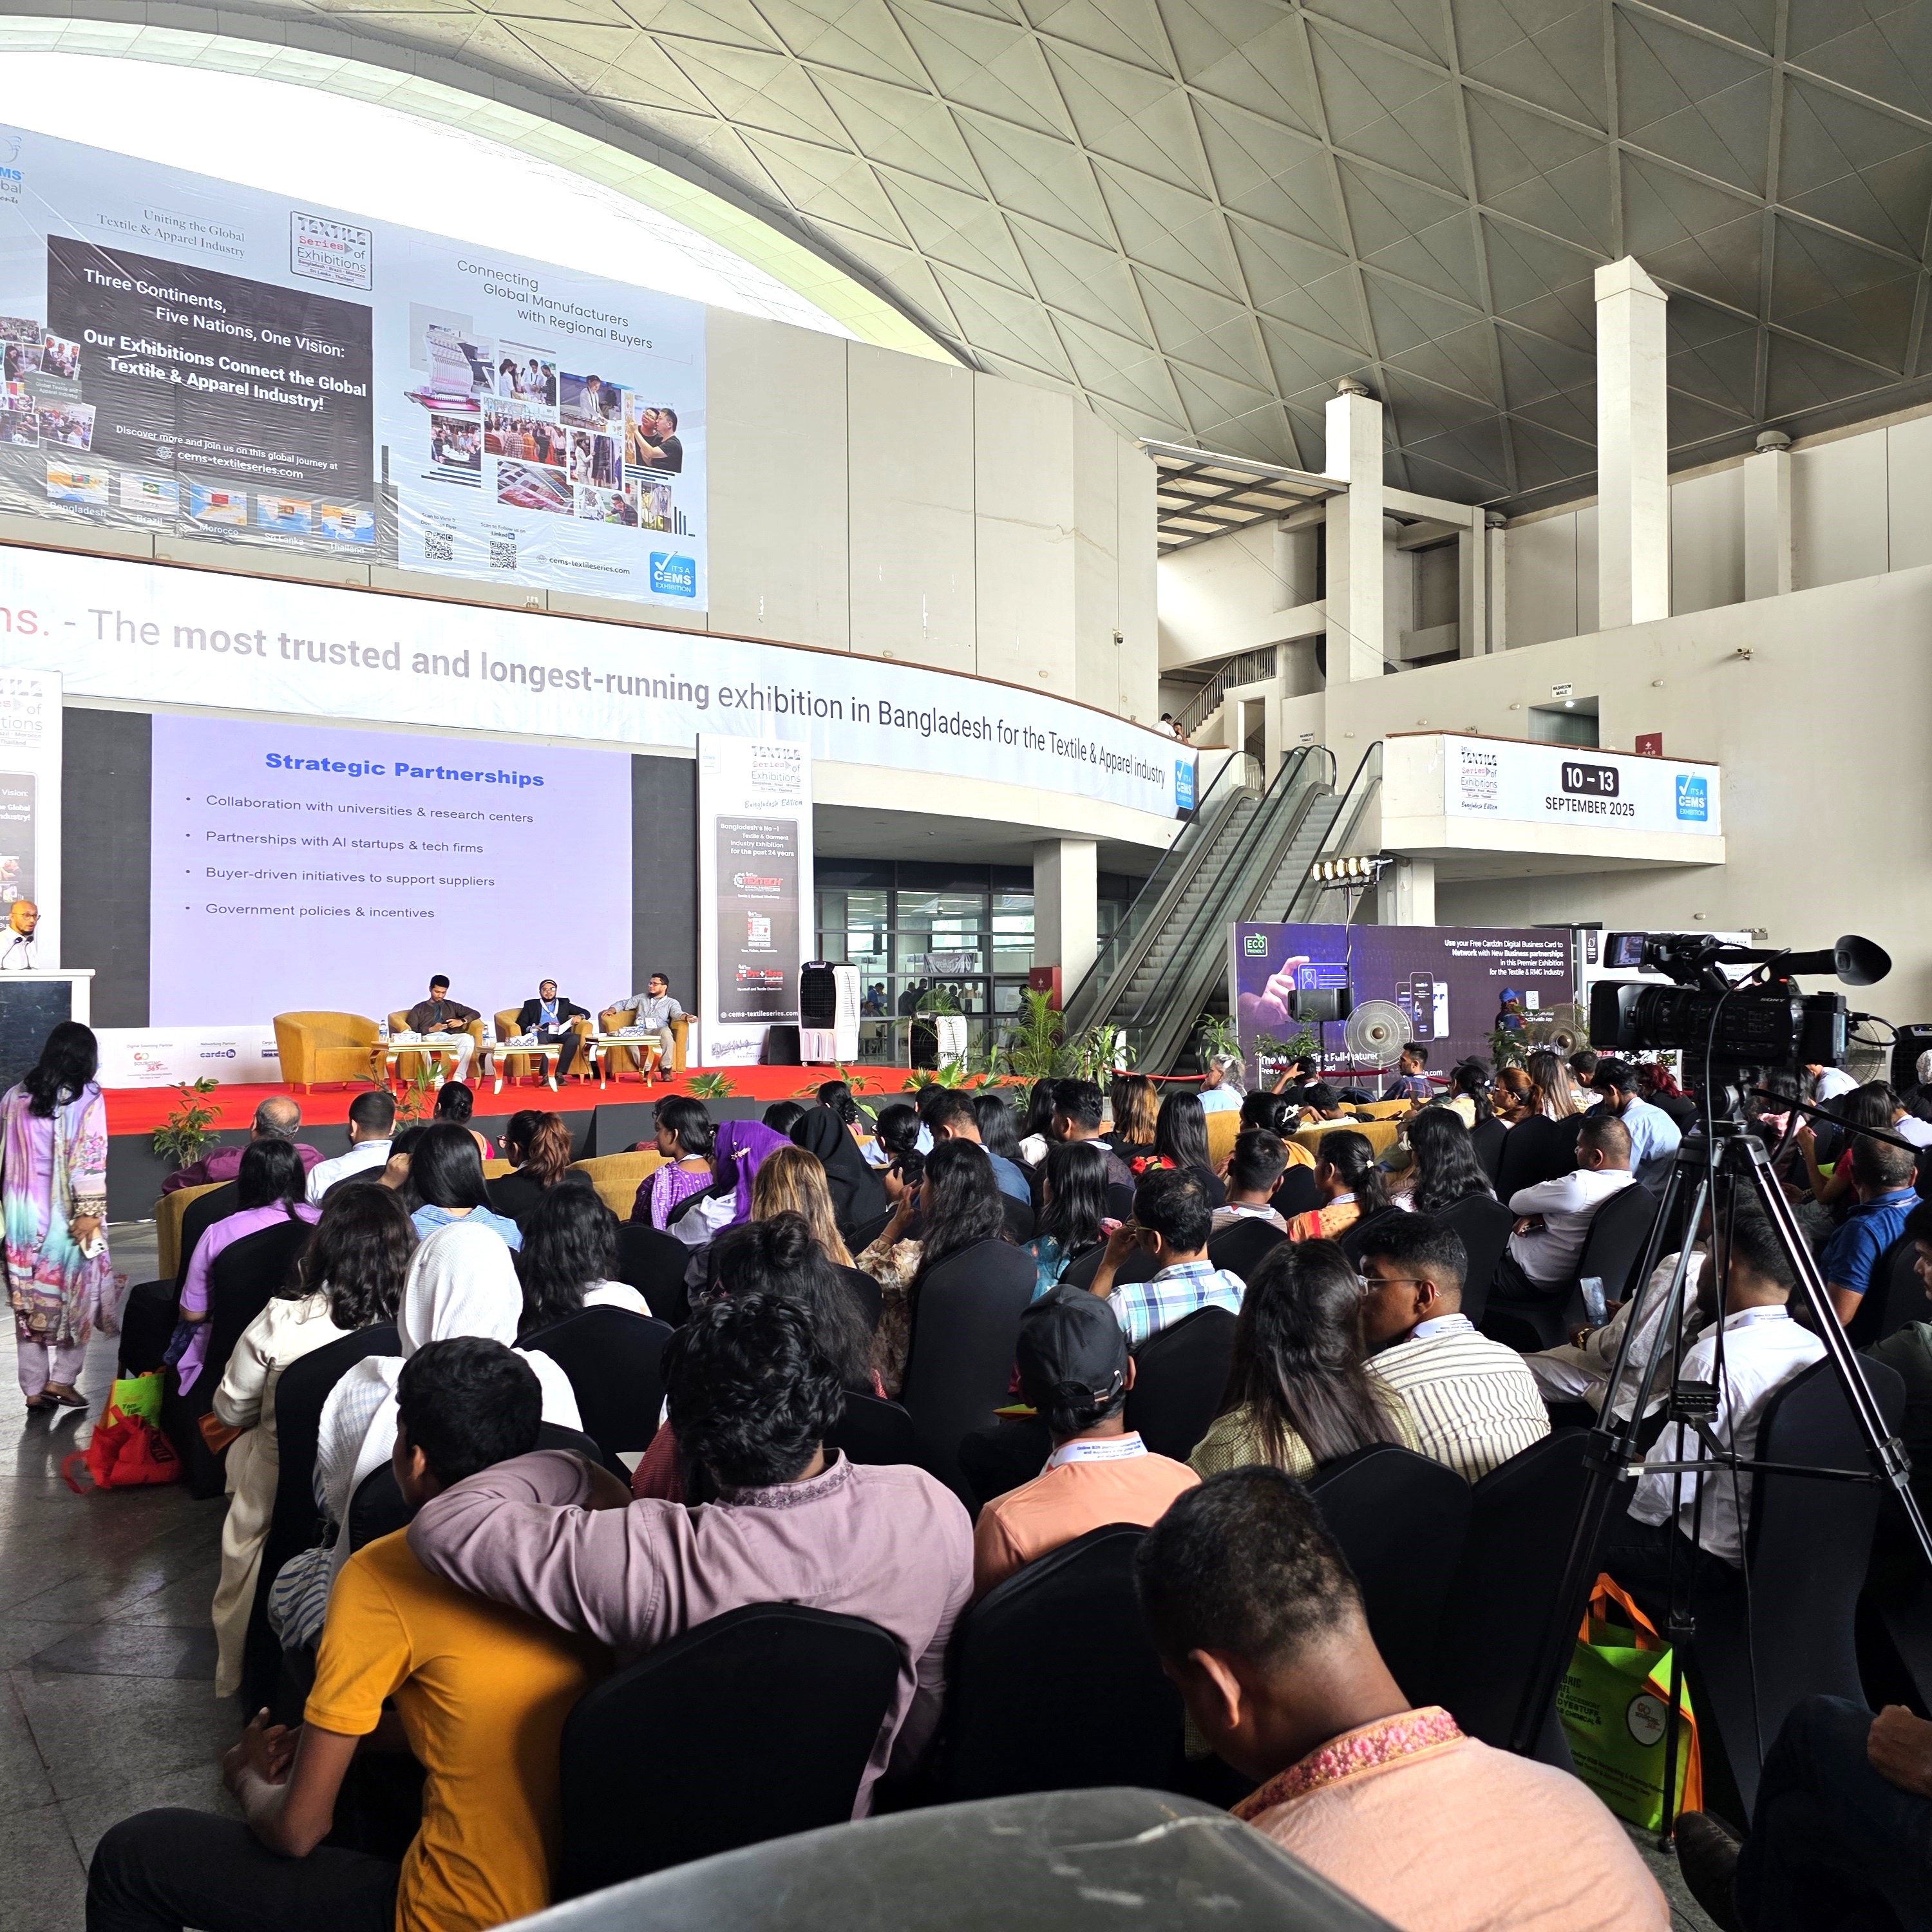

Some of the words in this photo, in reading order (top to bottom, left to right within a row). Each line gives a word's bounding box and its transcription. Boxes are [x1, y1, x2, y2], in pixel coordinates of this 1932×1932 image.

[97, 213, 137, 232] Textile
[140, 224, 151, 236] &
[154, 227, 197, 247] Apparel
[200, 237, 245, 259] Industry
[144, 209, 185, 229] Uniting
[189, 219, 206, 232] the
[209, 225, 245, 242] Global
[298, 216, 366, 245] TEXTILE
[299, 235, 344, 251] Series
[354, 251, 366, 260] of
[298, 247, 366, 272] Exhibitions
[457, 260, 539, 292] Connecting
[84, 268, 132, 291] Three
[137, 280, 227, 314] Continents,
[484, 283, 529, 305] Global
[533, 294, 629, 327] Manufacturers
[156, 307, 189, 328] Five
[193, 316, 257, 342] Nations,
[261, 330, 292, 347] One
[296, 335, 345, 358] Vision:
[518, 309, 546, 325] with
[549, 316, 607, 339] Regional
[611, 329, 653, 349] Buyers
[84, 328, 115, 348] Our
[120, 336, 214, 367] Exhibitions
[219, 357, 285, 383] Connect
[289, 371, 315, 387] the
[319, 376, 367, 397] Global
[108, 357, 166, 380] Textile
[170, 370, 183, 384] &
[187, 372, 250, 401] Apparel
[254, 385, 324, 412] Industry!
[116, 425, 158, 439] Discover
[160, 433, 184, 444] more
[185, 437, 203, 447] and
[204, 439, 221, 452] join
[223, 444, 234, 453] us
[236, 446, 248, 455] on
[249, 446, 265, 457] this
[268, 450, 294, 465] global
[296, 453, 327, 470] journey
[329, 461, 338, 471] at
[177, 450, 303, 479] cems-textileseries.com
[50, 501, 107, 518] Bangladesh
[137, 515, 164, 526] Brazil
[200, 523, 240, 536] Morocco
[281, 535, 305, 545] Lanka
[330, 543, 365, 554] Thailand
[654, 571, 692, 585] CEMS
[656, 582, 691, 592] EXHIBITION
[0, 607, 50, 636] ns.
[88, 609, 160, 645] The
[173, 625, 267, 657] most
[278, 632, 401, 671] trusted
[412, 649, 470, 678] and
[481, 651, 710, 710] longest-running
[718, 683, 842, 720] exhibition
[851, 696, 870, 723] in
[878, 701, 992, 741] Bangladesh
[997, 720, 1019, 742] for
[1023, 724, 1045, 751] the
[1048, 732, 1086, 762] Textile
[1090, 743, 1097, 764] &
[1099, 744, 1133, 775] Apparel
[1133, 753, 1166, 790] industry
[26, 703, 42, 715] of
[752, 746, 800, 761] TEXTILE
[1461, 752, 1497, 766] TEXTILE
[265, 752, 386, 778] Strategic
[395, 762, 545, 788] Partnerships
[752, 771, 801, 782] Exhibitions
[1566, 767, 1583, 788] 10
[1598, 770, 1614, 791] 13
[1177, 781, 1192, 795] CEMS
[1461, 777, 1497, 788] Exhibitions
[206, 795, 301, 811] Collaboration
[306, 799, 334, 813] with
[337, 802, 413, 817] universities
[417, 807, 426, 818] &
[430, 808, 485, 821] research
[489, 811, 534, 823] centers
[1546, 797, 1607, 815] SEPTEMBER
[1609, 802, 1634, 817] 2025
[1678, 797, 1705, 809] CEMS
[1680, 808, 1705, 817] EXHIBITION
[206, 831, 297, 848] Partnerships
[301, 835, 328, 847] with
[332, 836, 347, 848] AI
[351, 838, 404, 851] startups
[409, 840, 418, 851] &
[422, 841, 449, 852] tech
[453, 842, 484, 853] firms
[205, 867, 298, 882] Buyer-driven
[302, 869, 365, 883] initiatives
[370, 872, 382, 884] to
[386, 874, 435, 887] support
[439, 875, 495, 888] suppliers
[205, 904, 295, 917] Government
[299, 905, 351, 919] policies
[355, 907, 365, 918] &
[370, 906, 435, 919] incentives
[1530, 950, 1564, 958] partnerships
[134, 1052, 149, 1061] GO
